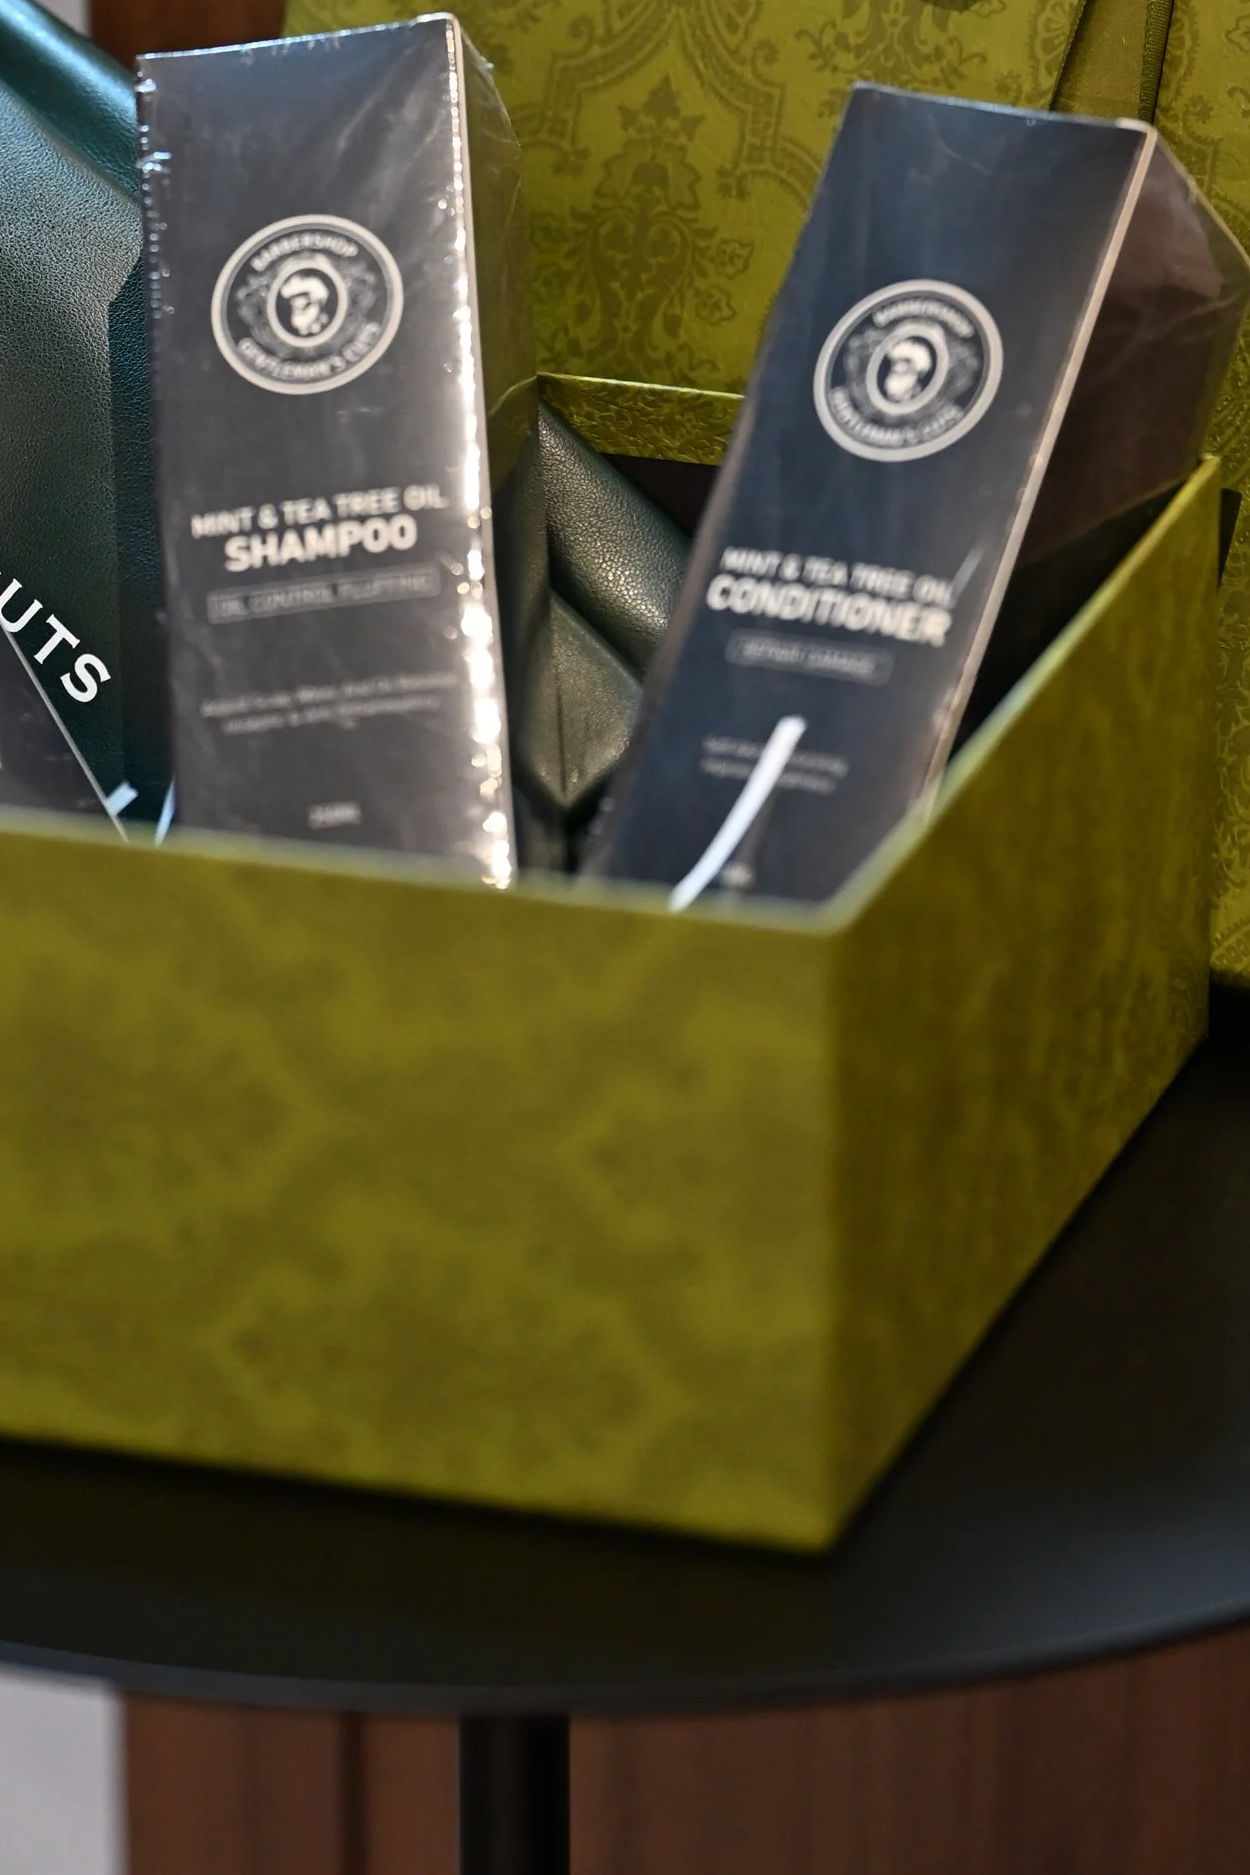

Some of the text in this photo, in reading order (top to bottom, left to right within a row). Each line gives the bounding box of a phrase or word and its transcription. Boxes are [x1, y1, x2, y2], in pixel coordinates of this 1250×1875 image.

[191, 483, 449, 539] MINT & TEA TREE OIL
[224, 513, 419, 573] SHAMPOO
[719, 546, 783, 576] MINT
[801, 555, 849, 586] TEA
[849, 561, 914, 599] TREE
[706, 573, 953, 648] CONDITIONER
